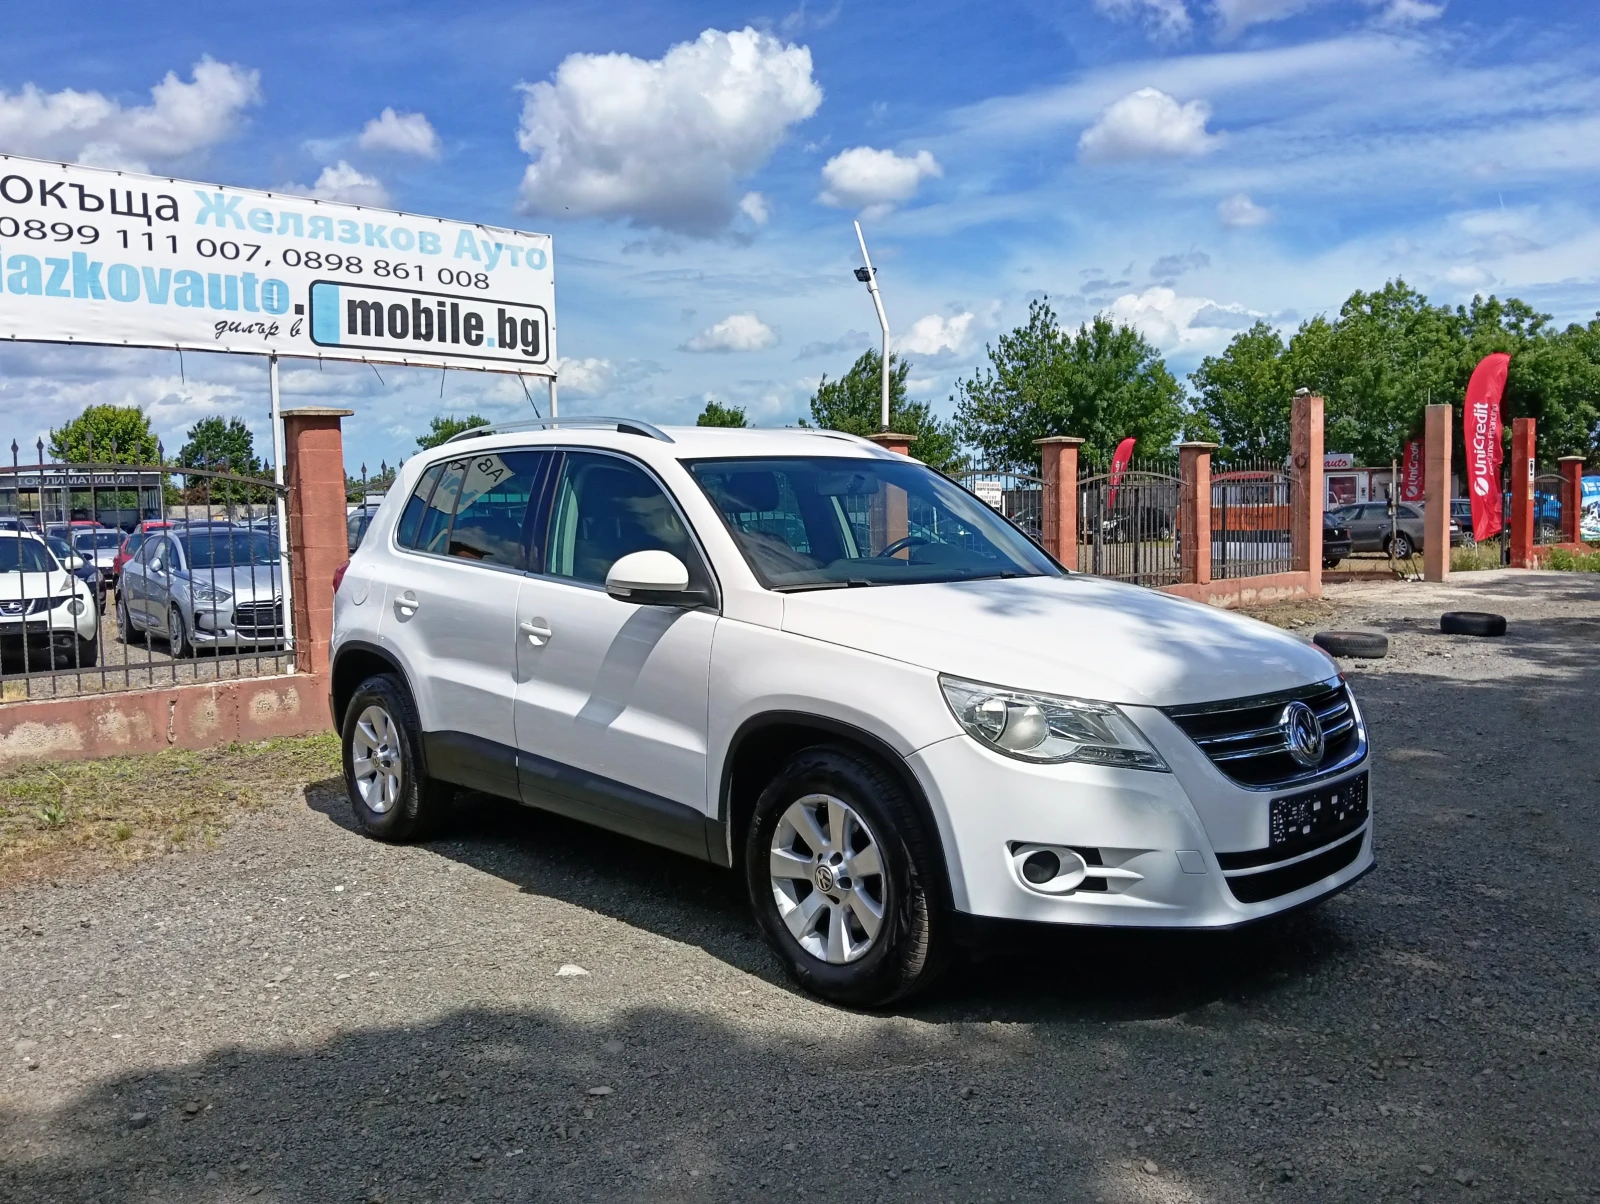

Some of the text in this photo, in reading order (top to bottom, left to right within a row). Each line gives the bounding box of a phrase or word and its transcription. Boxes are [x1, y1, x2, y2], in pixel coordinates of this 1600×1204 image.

[0, 216, 490, 290] 0899 111 007, 0898 861 008
[193, 190, 442, 255] Желязков
[454, 229, 547, 272] Ауто
[0, 245, 540, 357] azkovauto. mobile.bg
[214, 320, 280, 340] дилър
[1324, 458, 1348, 468] auto
[1407, 442, 1419, 485] UniCredit
[1473, 402, 1489, 476] UniCredit
